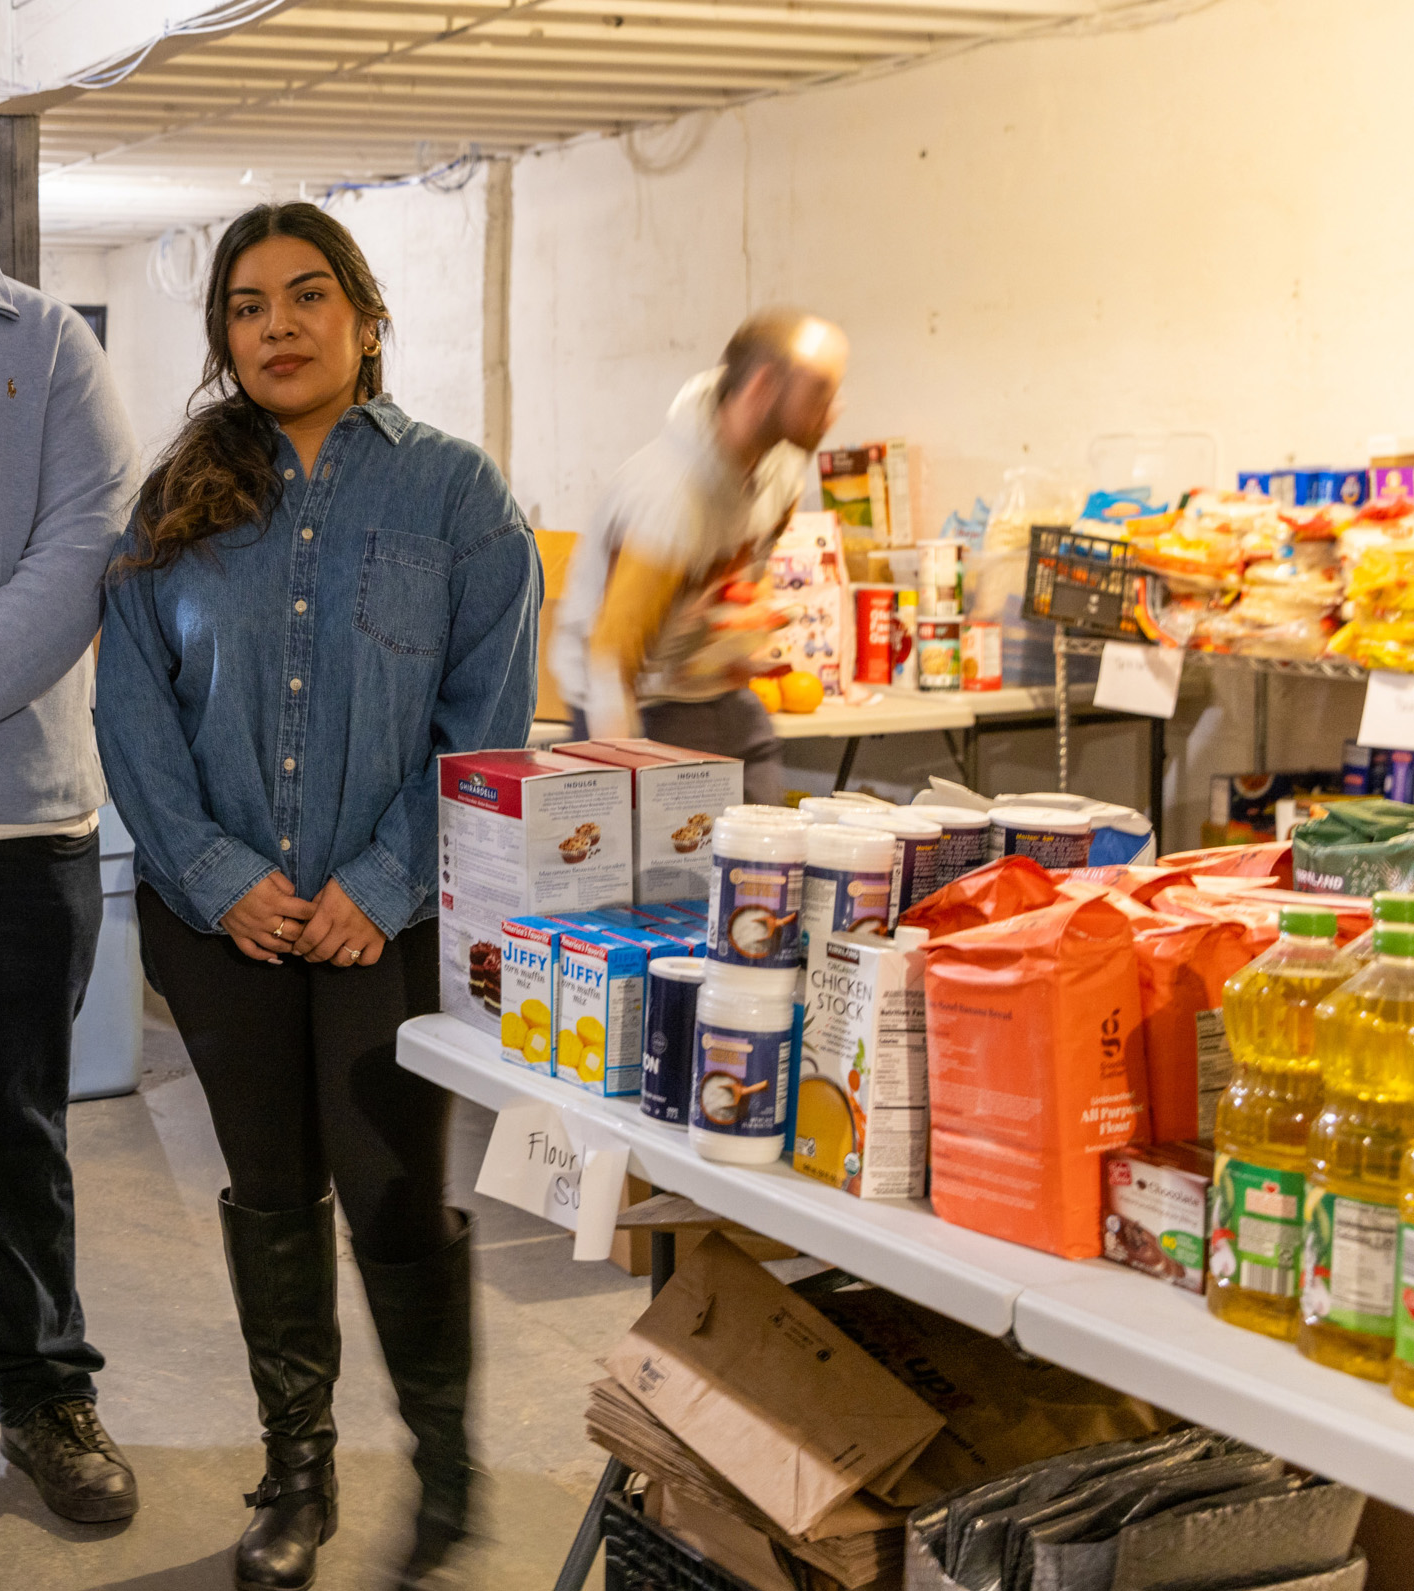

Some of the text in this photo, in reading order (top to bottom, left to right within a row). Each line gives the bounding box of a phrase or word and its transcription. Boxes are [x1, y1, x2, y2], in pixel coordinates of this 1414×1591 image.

[564, 780, 597, 789] INDULGE
[677, 771, 711, 780] INDULGE
[459, 781, 497, 800] GHIRARDELLI
[502, 921, 550, 944] America's Favorite
[503, 941, 548, 971] JIFFY
[561, 934, 607, 958] America's Favorite
[505, 963, 546, 984] corn muffin
[561, 956, 604, 988] JIFFY
[516, 977, 532, 989] mix
[561, 979, 601, 1000] corn muffin
[811, 969, 873, 1002] CHICKEN
[573, 992, 588, 1006] mix
[816, 992, 865, 1022] STOCK
[1081, 1102, 1144, 1123] All Purpose
[1100, 1119, 1131, 1136] Flour
[528, 1131, 578, 1171] Flour
[1148, 1180, 1200, 1208] Chocolate
